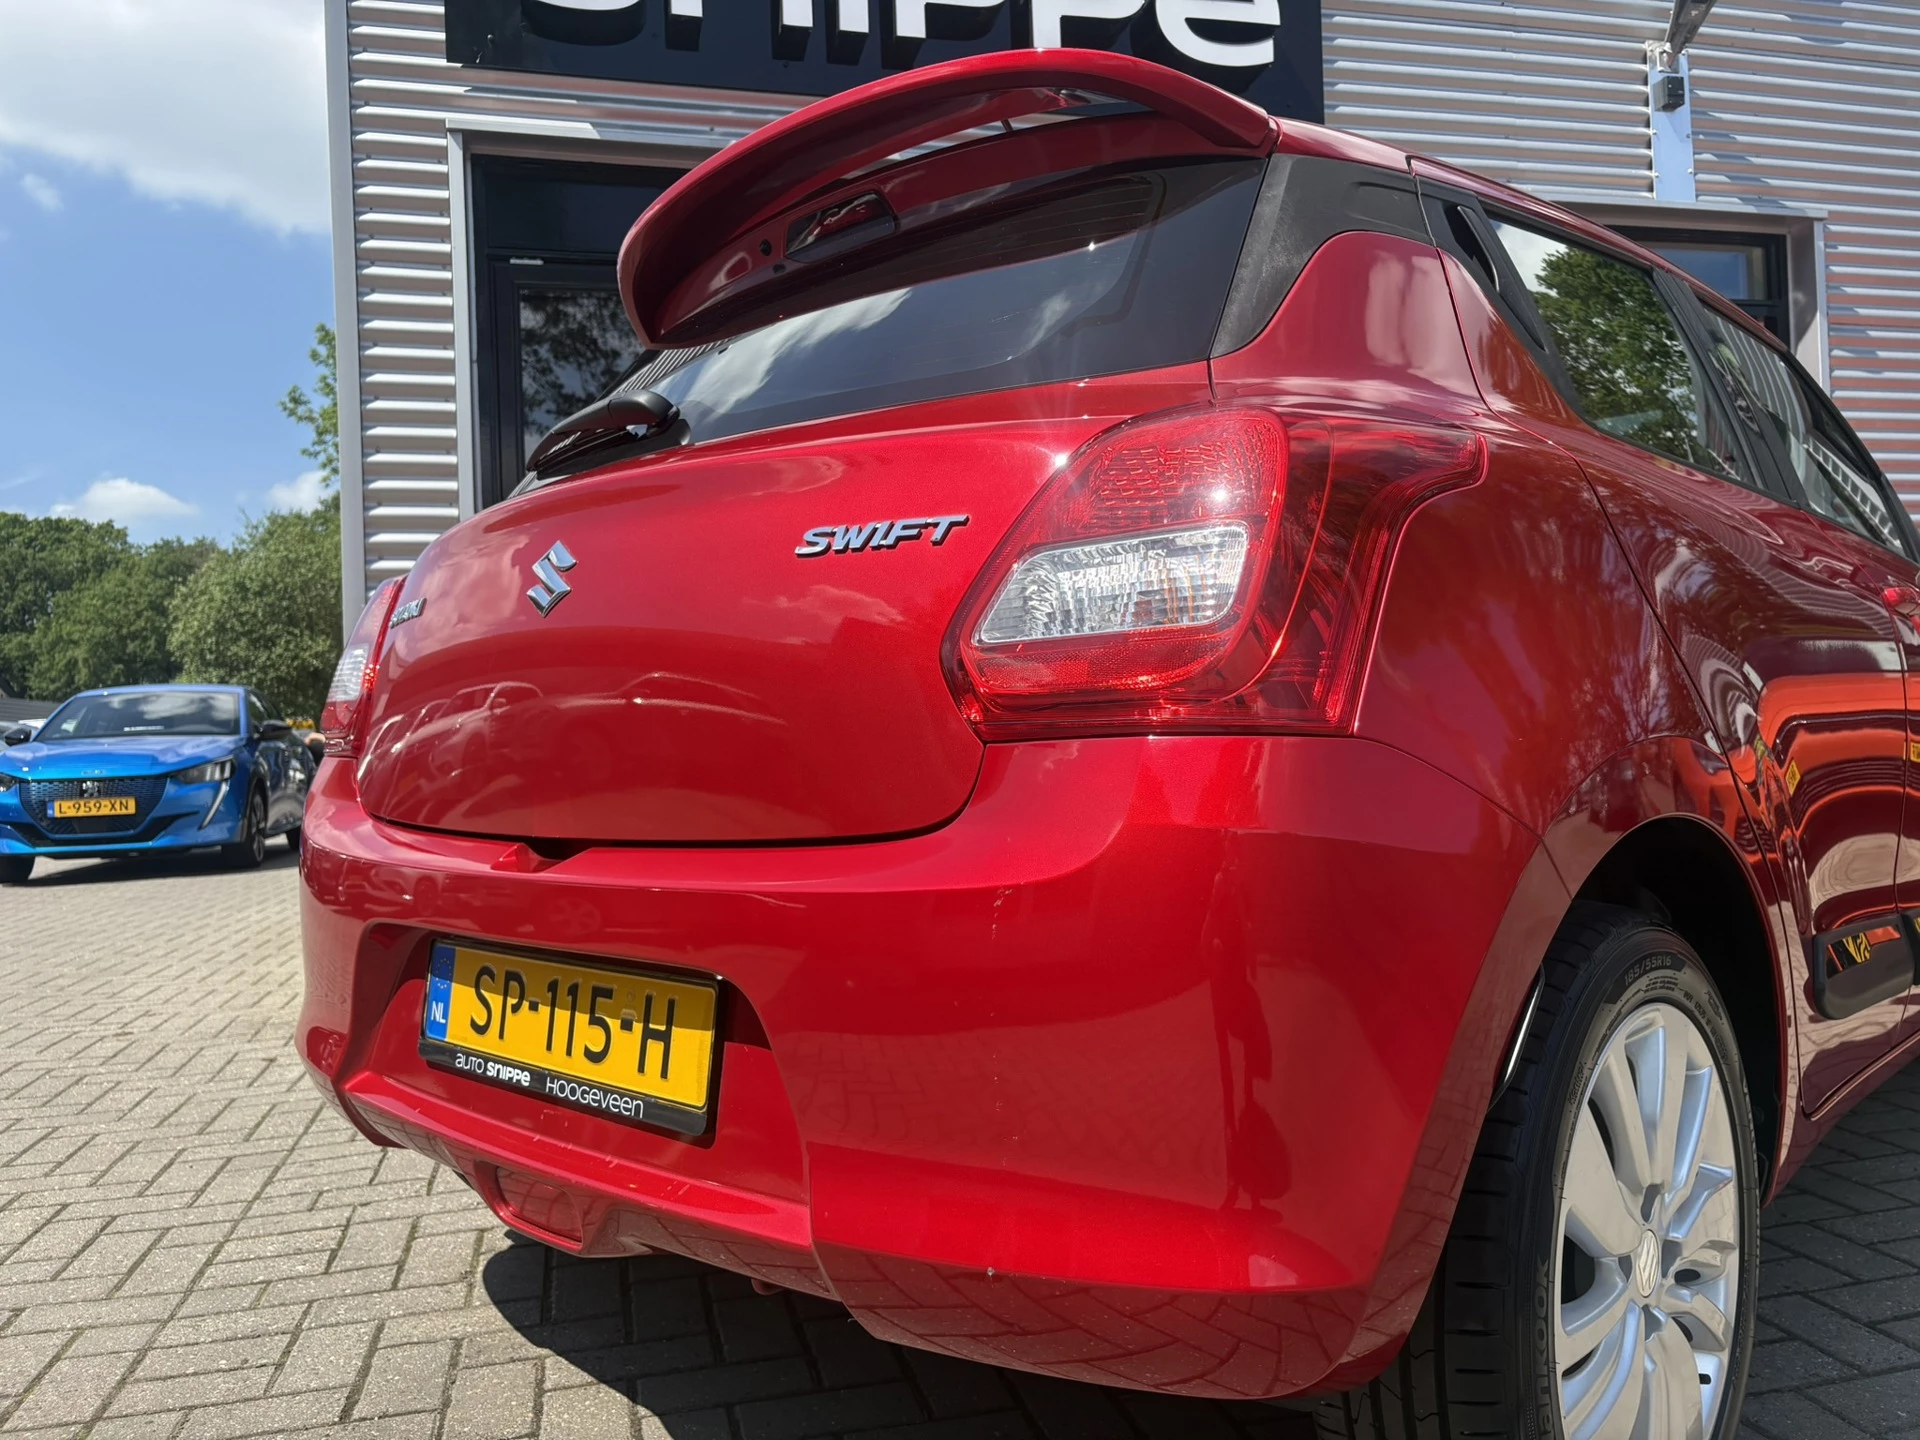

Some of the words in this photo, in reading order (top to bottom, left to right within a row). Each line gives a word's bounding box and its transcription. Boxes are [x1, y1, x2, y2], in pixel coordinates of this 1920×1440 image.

[794, 514, 971, 558] SWIFT
[58, 799, 129, 815] L-959-XN
[1624, 955, 1672, 986] 185/55R16
[431, 1000, 446, 1024] NL
[469, 964, 679, 1080] SP-115-H
